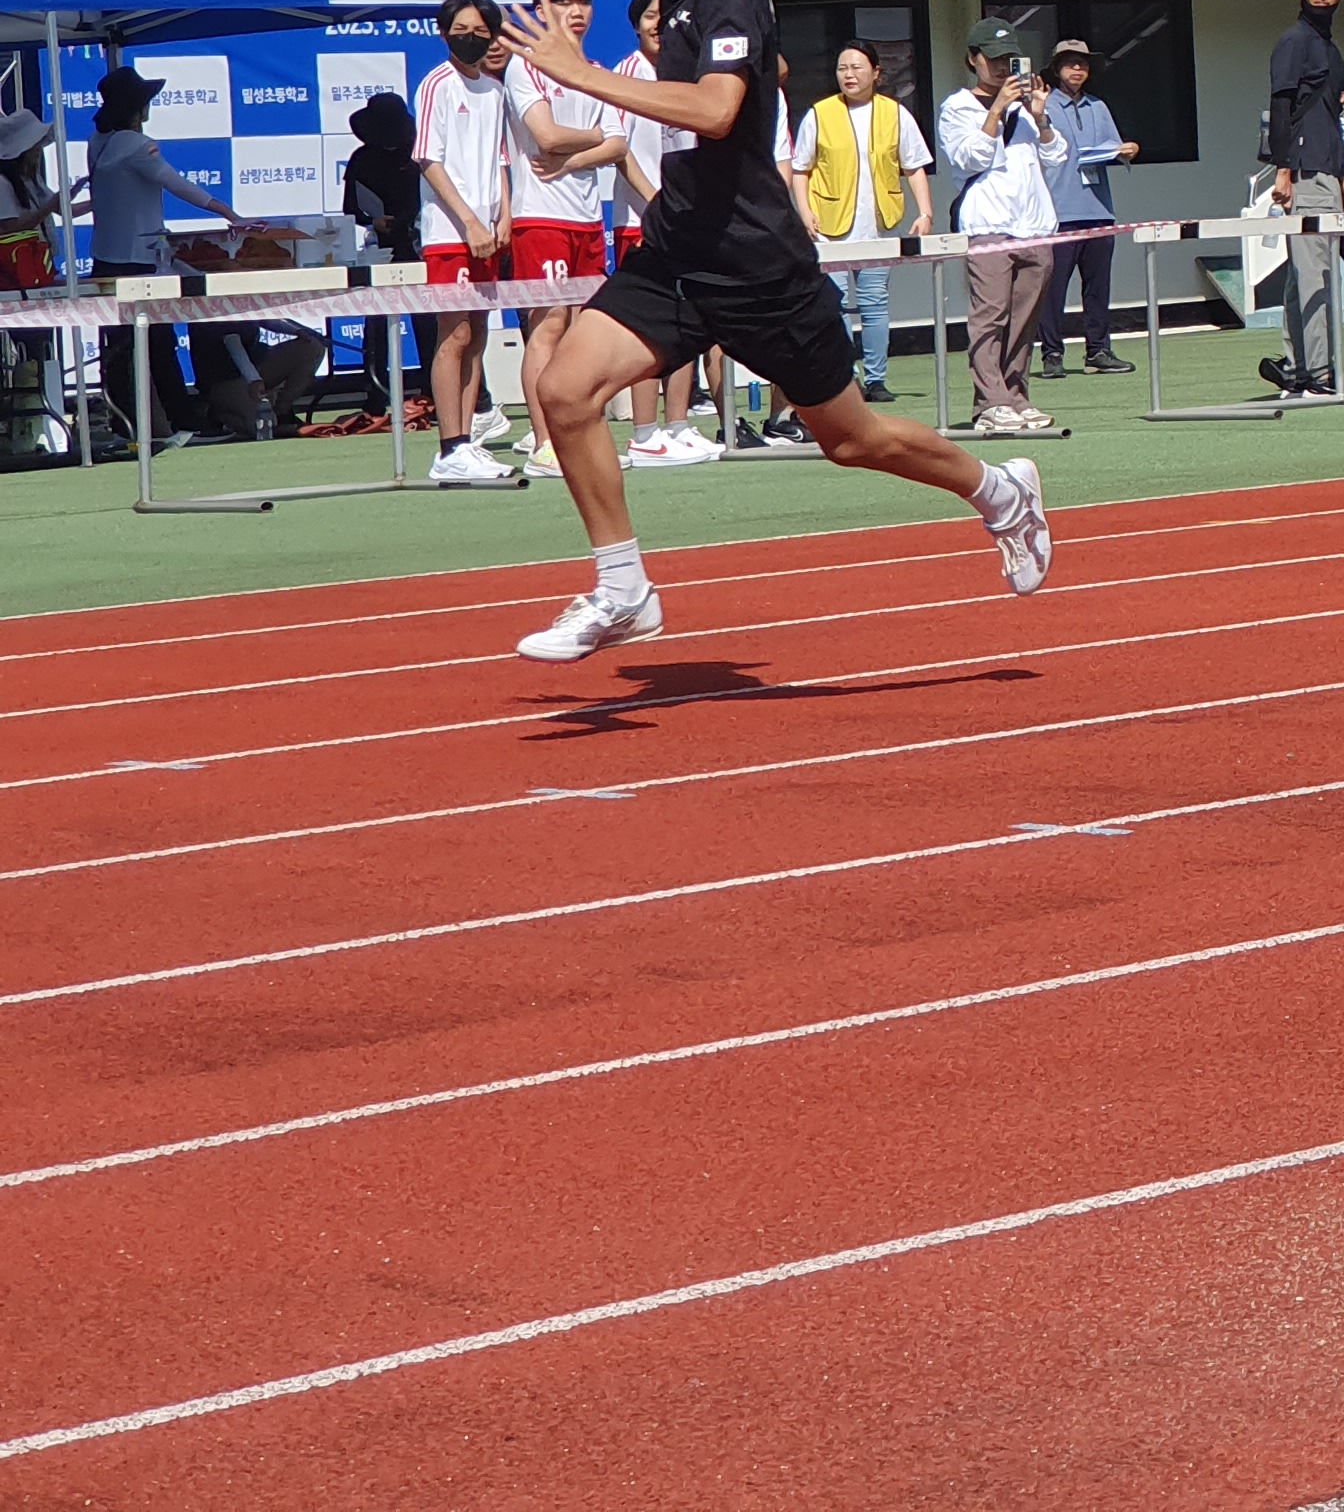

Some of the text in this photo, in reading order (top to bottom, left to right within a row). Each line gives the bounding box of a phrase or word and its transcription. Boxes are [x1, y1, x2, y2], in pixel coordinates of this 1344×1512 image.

[241, 86, 309, 105] 밀성초등학교
[239, 166, 317, 185] 삼랑진초등학교
[457, 267, 471, 285] 6
[542, 259, 569, 285] 18
